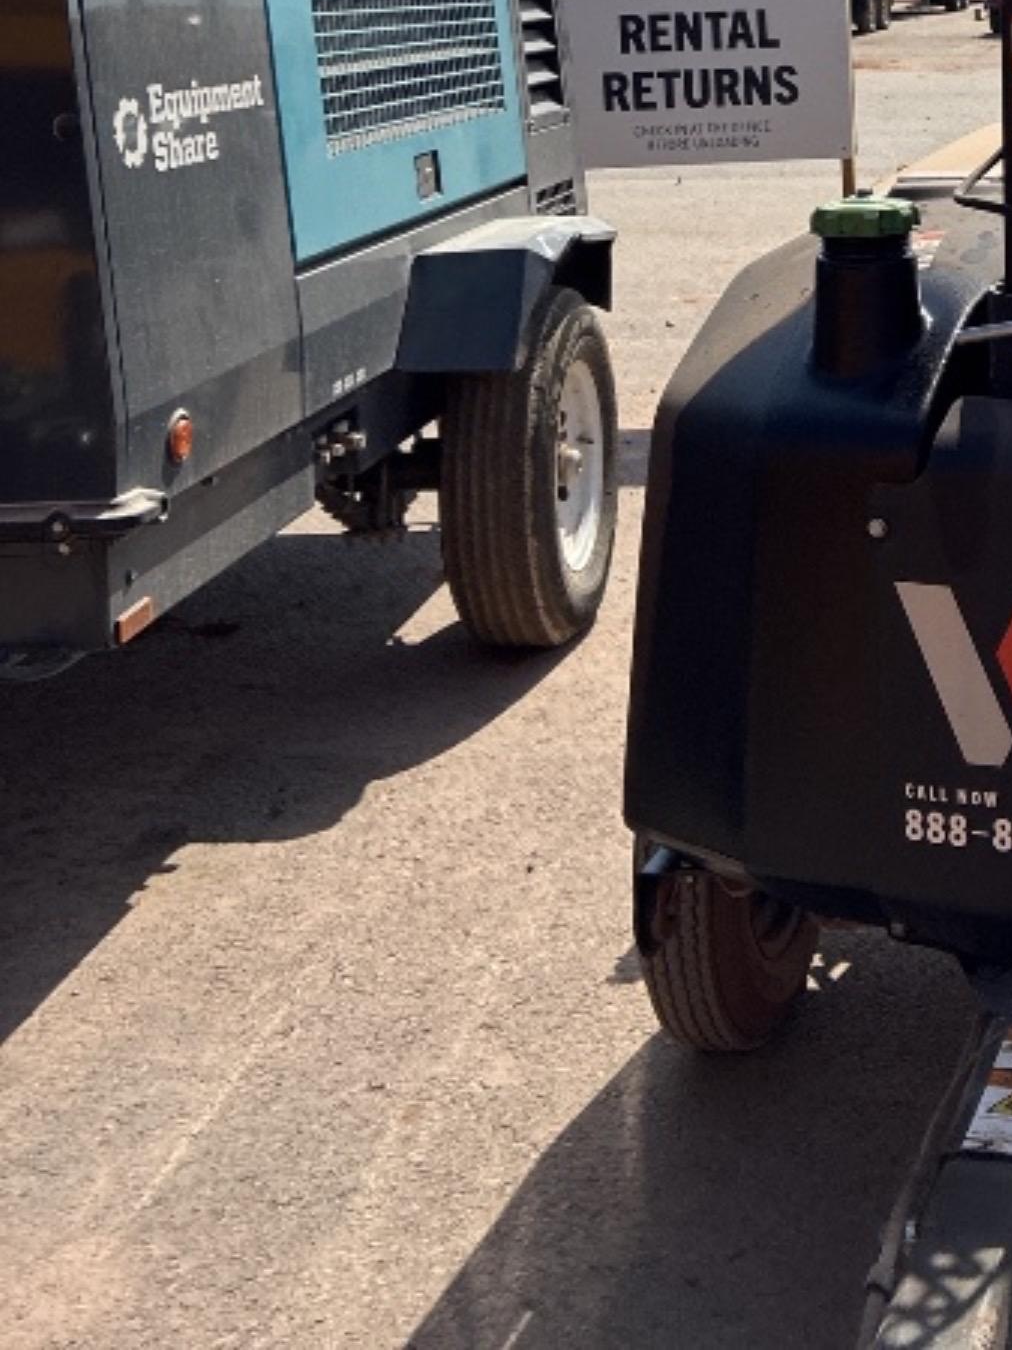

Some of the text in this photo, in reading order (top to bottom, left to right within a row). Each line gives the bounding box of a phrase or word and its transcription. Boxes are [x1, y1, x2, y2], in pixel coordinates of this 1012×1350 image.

[620, 9, 780, 54] RENTAL
[146, 74, 264, 130] Equipment
[602, 65, 799, 112] RETURNS
[152, 131, 219, 172] Share
[905, 782, 998, 808] CALL NOW
